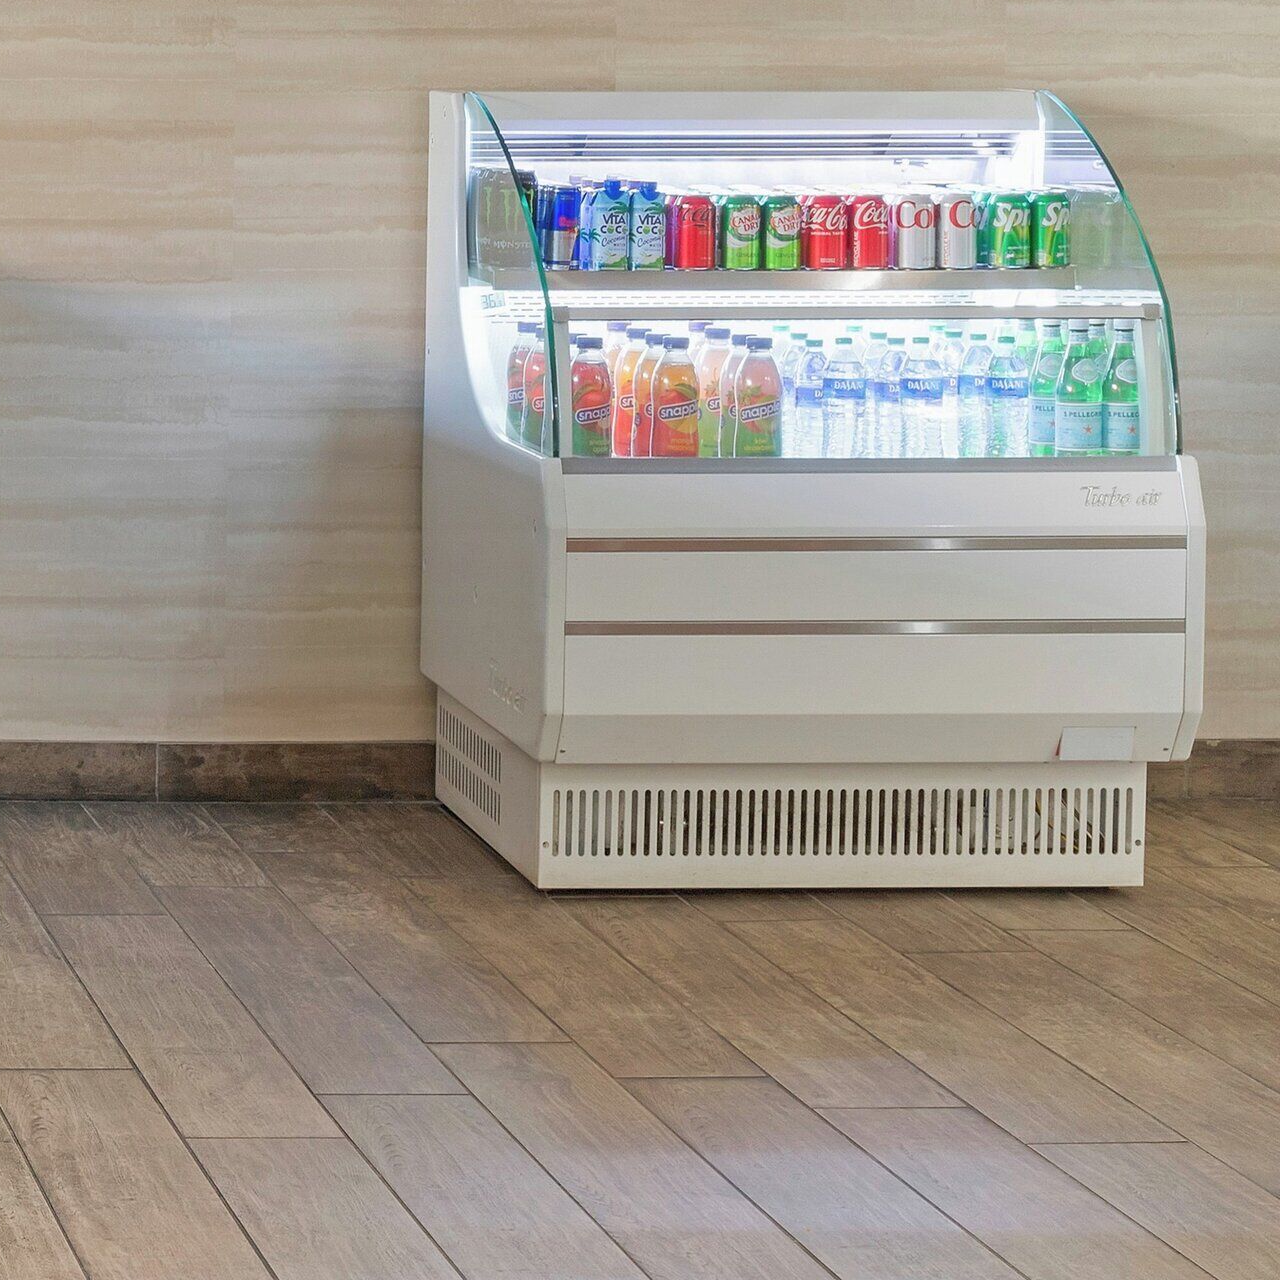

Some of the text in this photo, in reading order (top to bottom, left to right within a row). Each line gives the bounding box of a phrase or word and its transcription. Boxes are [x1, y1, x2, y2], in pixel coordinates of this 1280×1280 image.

[603, 213, 626, 225] VITA
[638, 213, 662, 225] VITA
[993, 202, 1030, 232] Spr
[992, 379, 1024, 390] DASANI
[578, 407, 610, 421] snapp
[659, 401, 698, 419] snappl
[1080, 486, 1130, 508] Turbo
